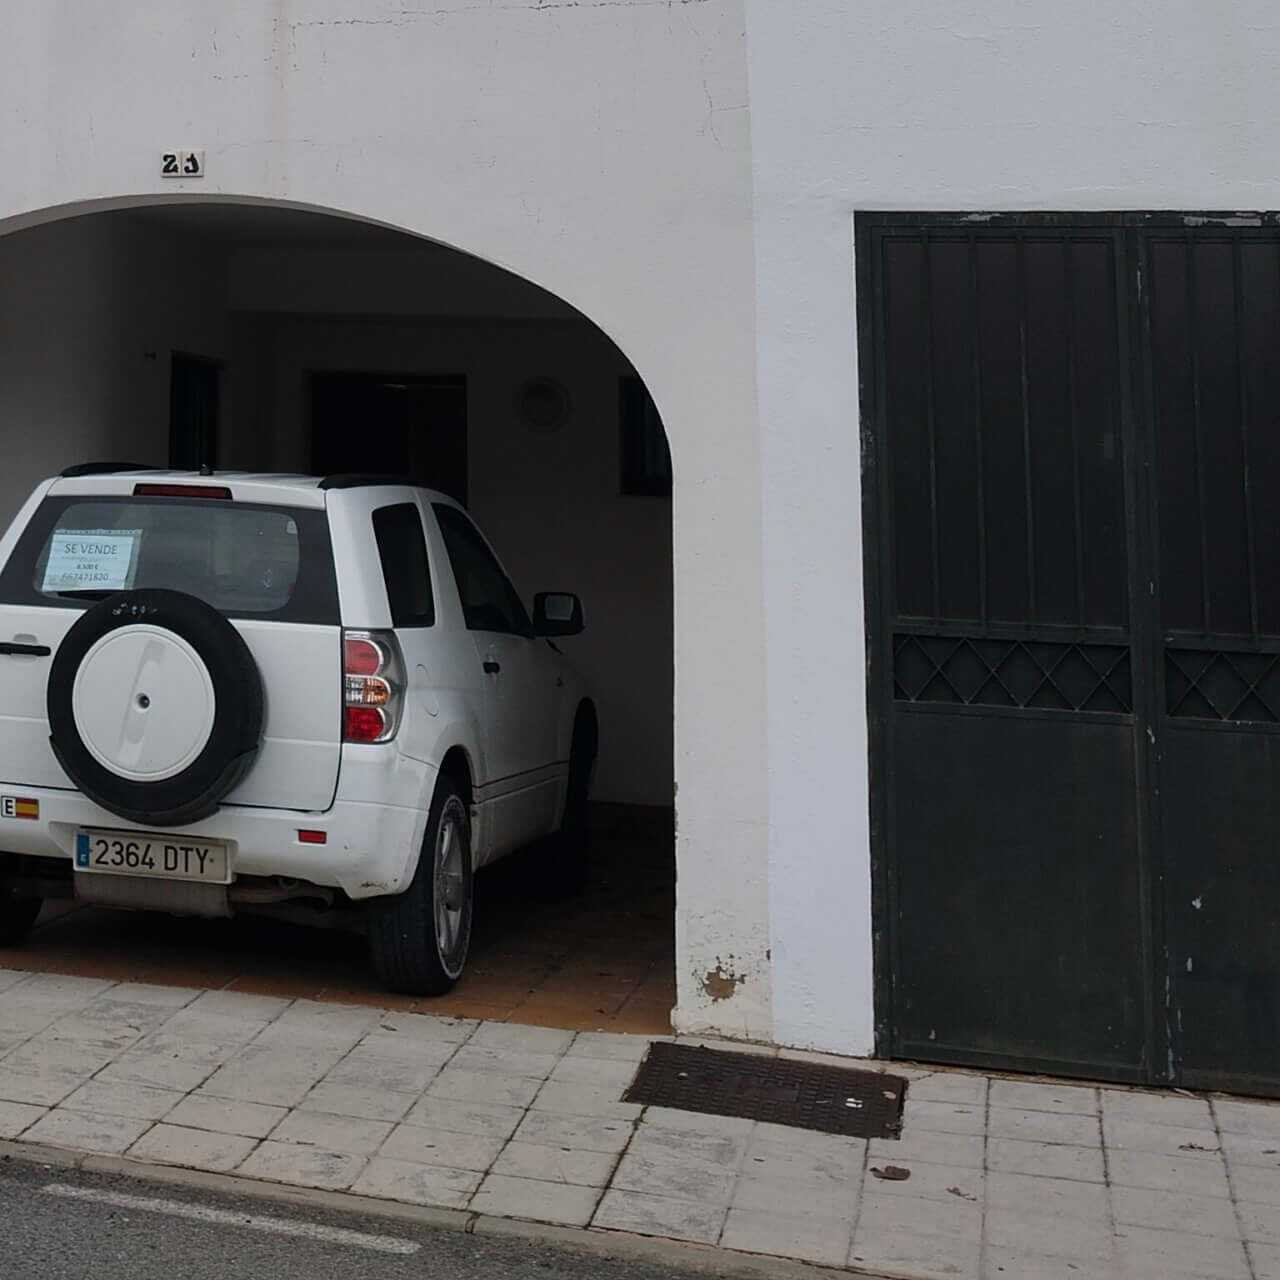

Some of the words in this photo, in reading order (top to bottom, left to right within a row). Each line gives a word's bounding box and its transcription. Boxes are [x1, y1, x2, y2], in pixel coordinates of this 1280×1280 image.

[64, 543, 77, 554] SE
[80, 543, 118, 555] VENDE
[5, 799, 13, 815] E
[95, 839, 155, 870] 2364
[164, 845, 209, 874] DTY
